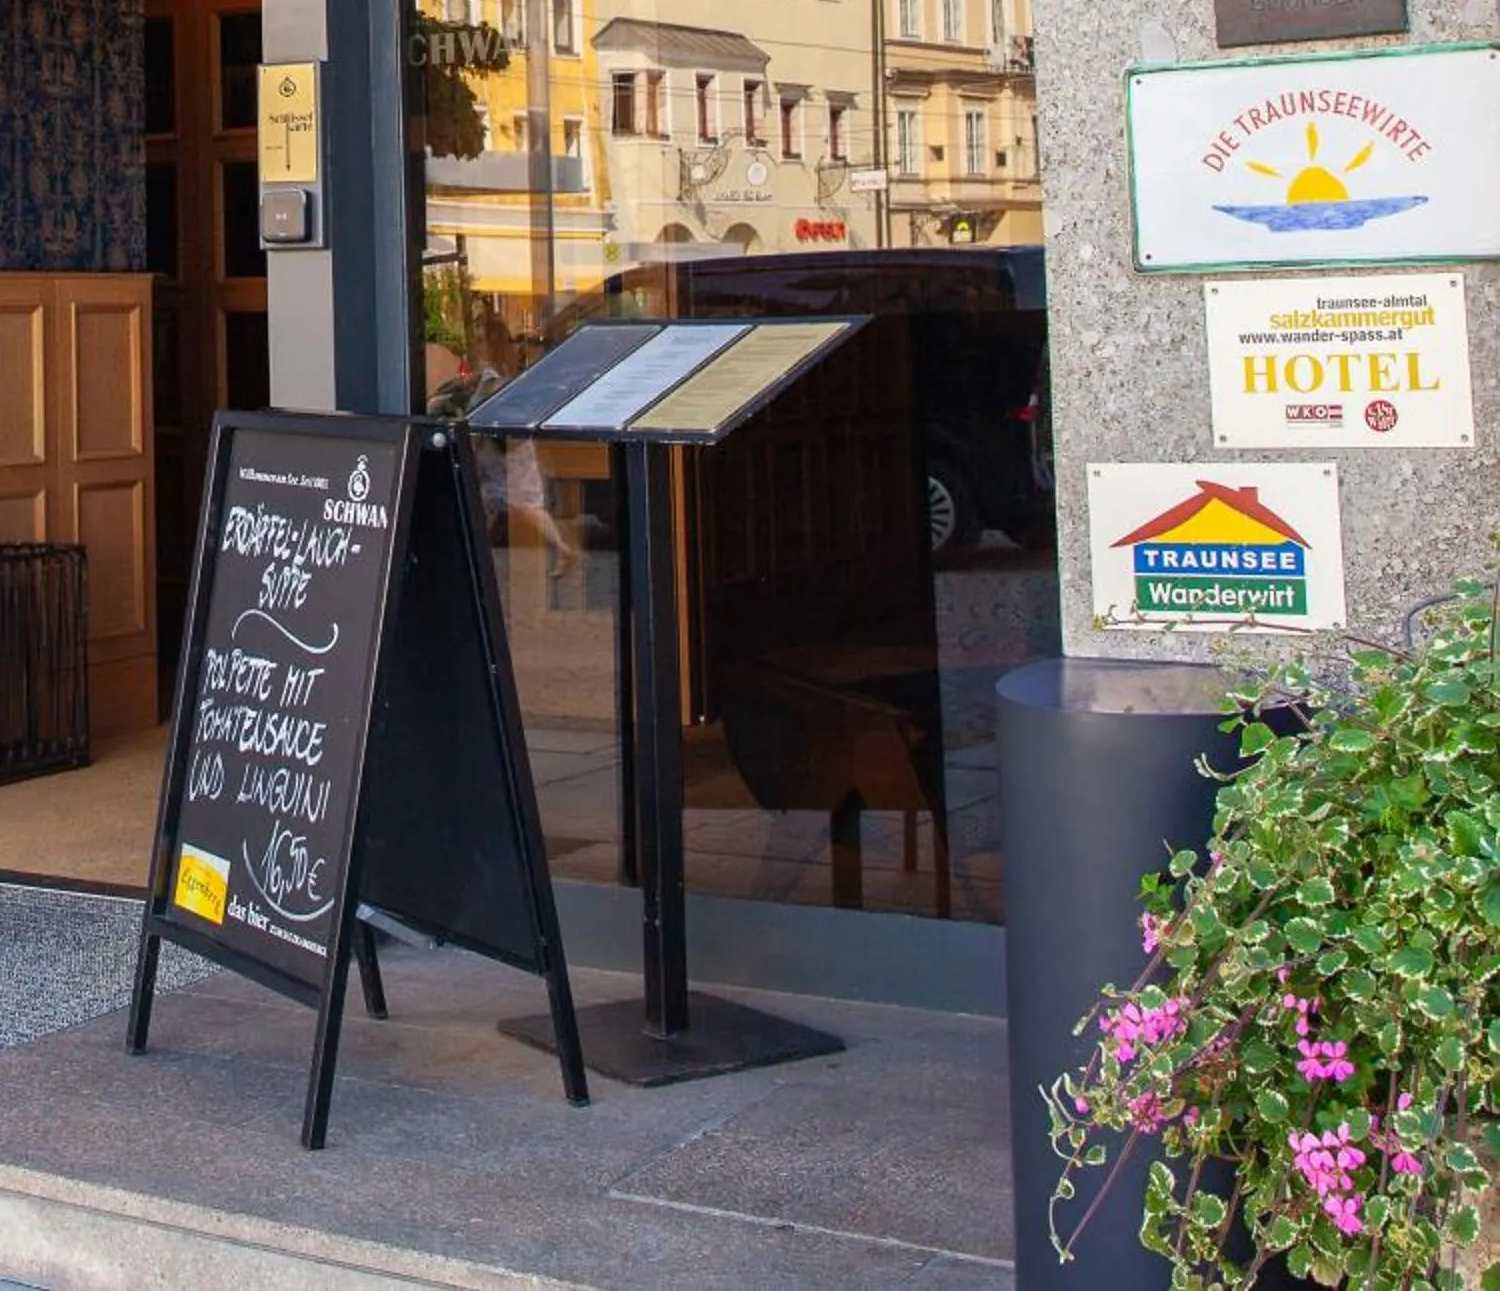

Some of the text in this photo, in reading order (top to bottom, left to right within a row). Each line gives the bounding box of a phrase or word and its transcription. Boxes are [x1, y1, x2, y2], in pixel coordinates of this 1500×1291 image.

[1203, 89, 1432, 174] DIE TRAUNSEEWIRTE
[1316, 293, 1428, 309] traunsee-almtal
[1269, 306, 1436, 330] salzkammergut
[1238, 327, 1404, 345] www.wander-spass.at
[1243, 351, 1440, 393] HOTEL
[1287, 406, 1327, 419] WKO
[323, 498, 388, 529] SCHWAN
[1143, 549, 1297, 571] TRAUNSEE
[258, 561, 312, 610] SUPPE
[1148, 581, 1296, 607] Wanderwirt
[203, 648, 325, 708] POLPETTE MIT
[195, 698, 327, 766] TOMATENSAUCE
[188, 749, 331, 823] UND LINGUINI
[227, 894, 247, 922] das
